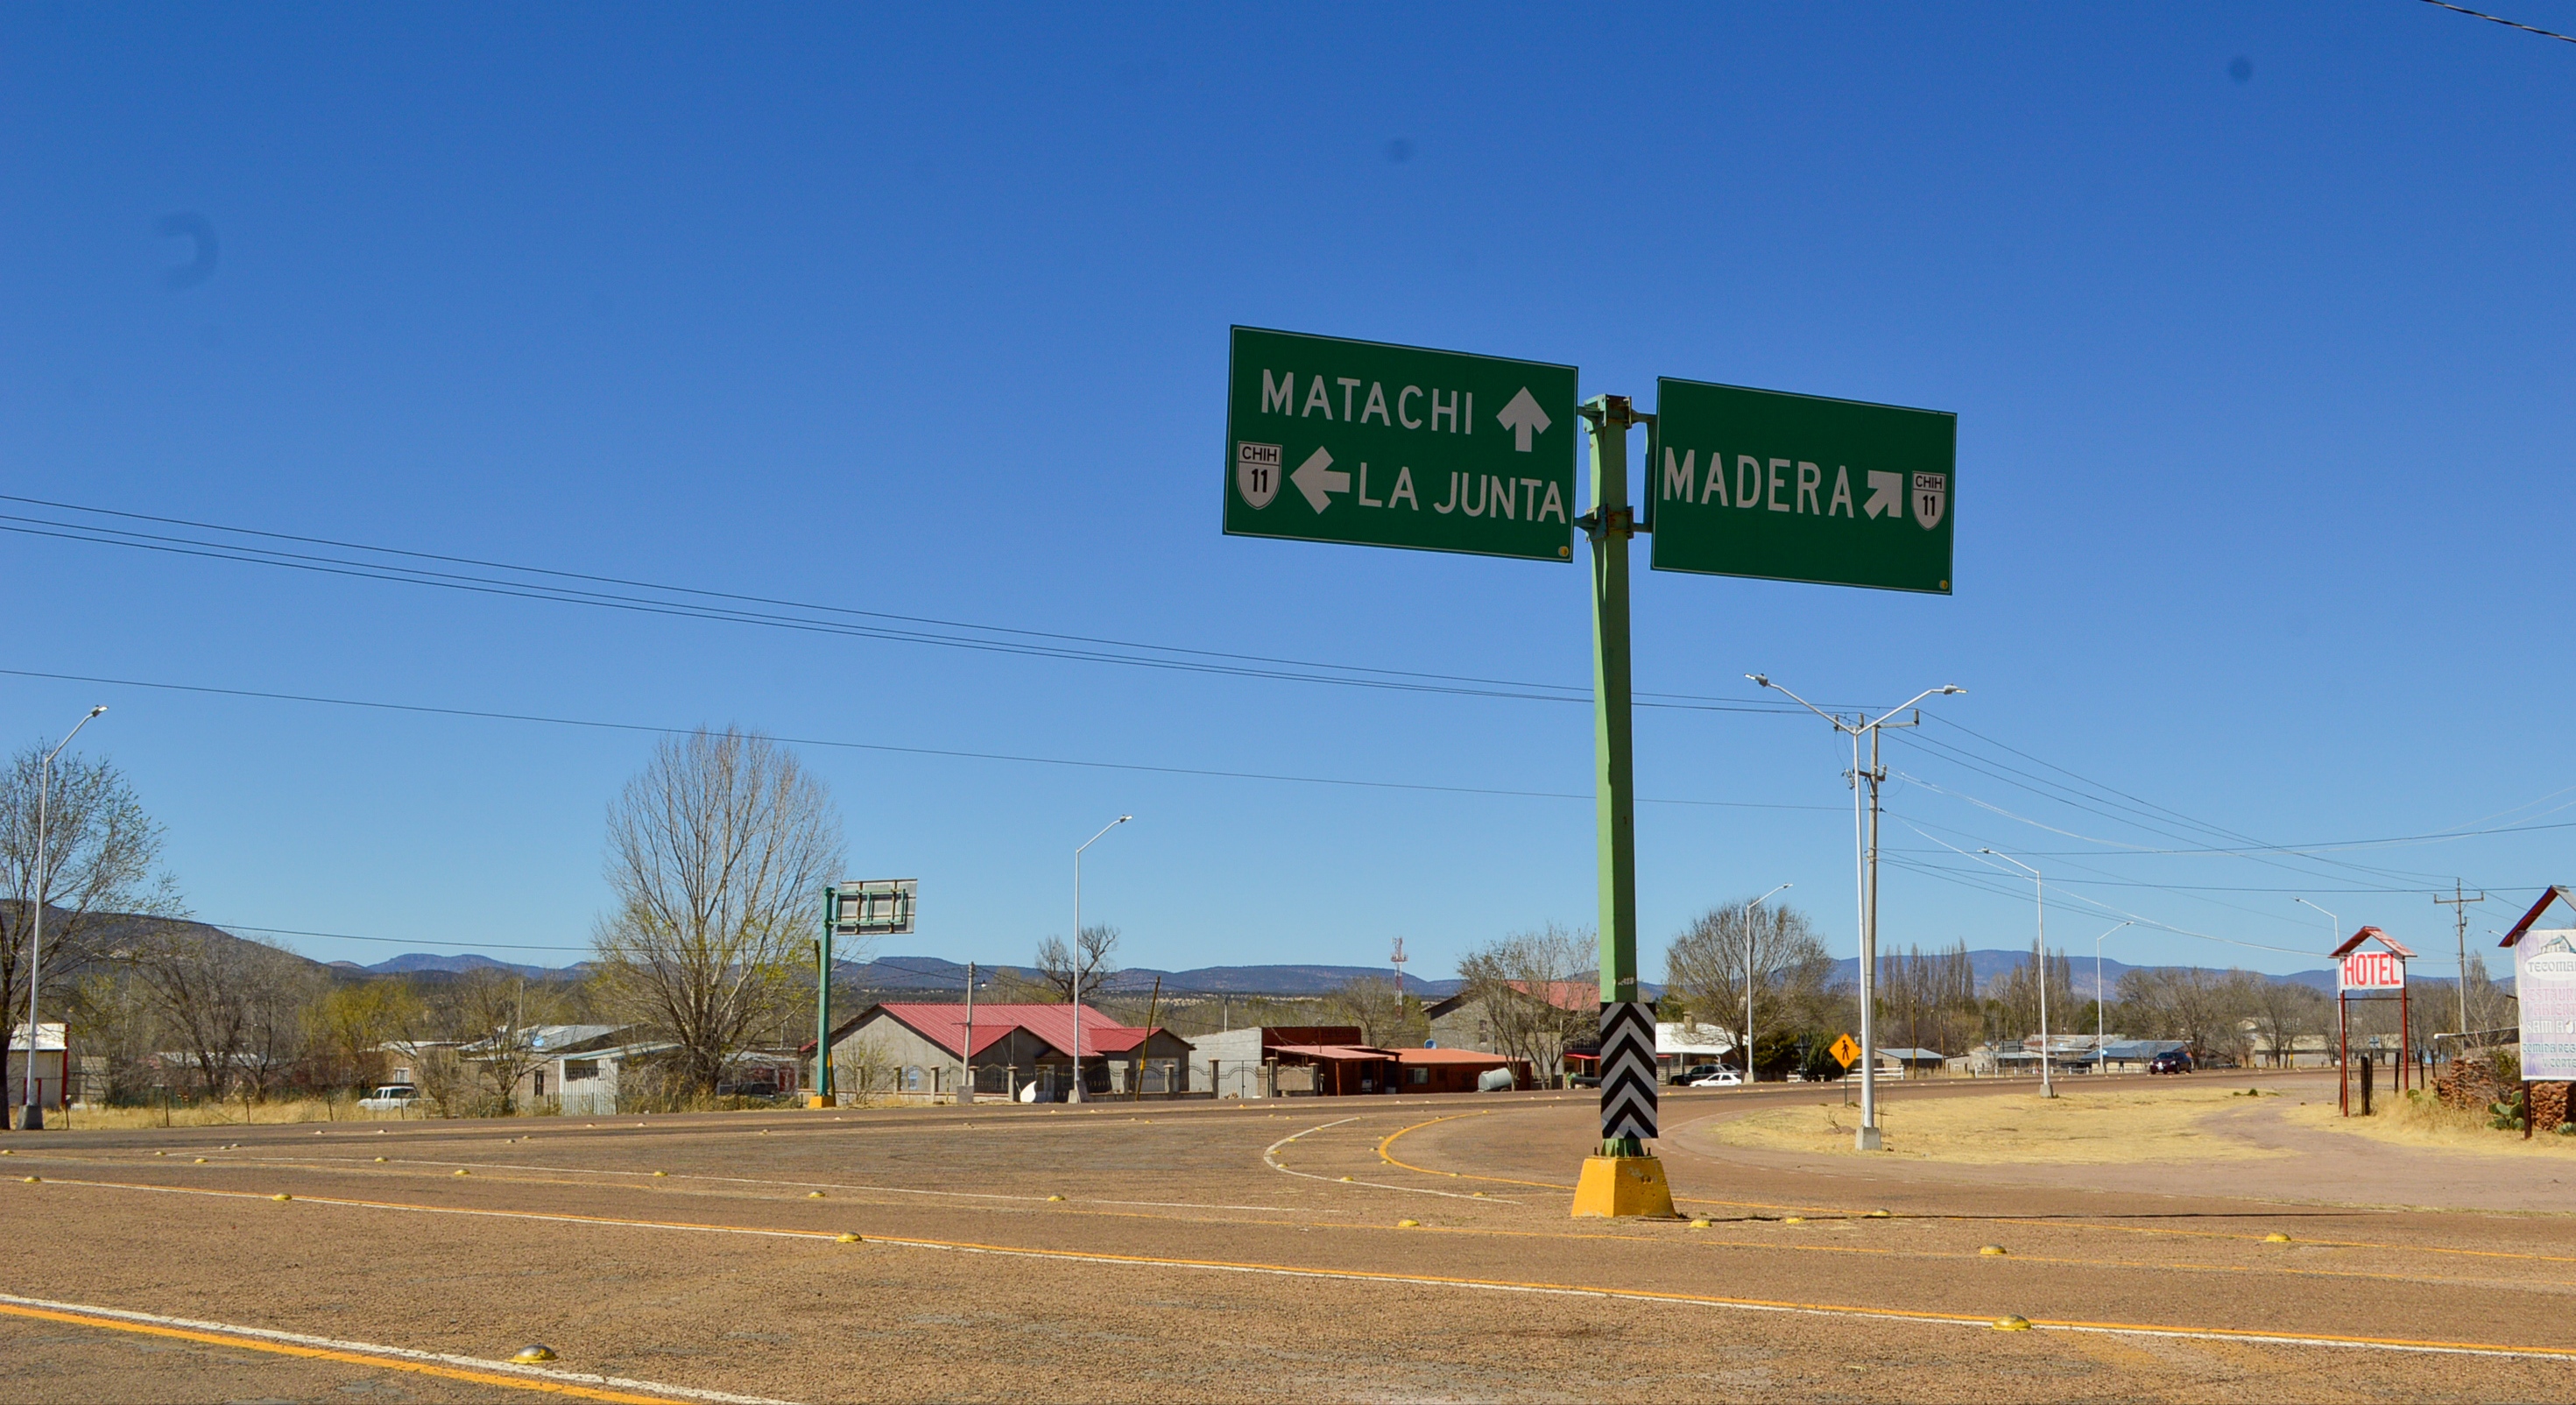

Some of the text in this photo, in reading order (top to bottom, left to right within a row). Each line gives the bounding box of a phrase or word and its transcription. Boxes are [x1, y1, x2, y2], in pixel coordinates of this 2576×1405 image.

[1261, 369, 1472, 434] MATACHI
[1242, 446, 1277, 462] CHIH
[1251, 469, 1268, 493] 11
[1663, 447, 1854, 519] MADERA
[1916, 475, 1943, 490] CHIH
[1359, 462, 1566, 524] LA JUNTA
[1923, 494, 1936, 517] 11
[2344, 953, 2400, 986] HOTEL
[2528, 961, 2576, 972] TECOMA
[2522, 988, 2576, 1001] RESTAUR
[2522, 1043, 2556, 1053] COMIDA
